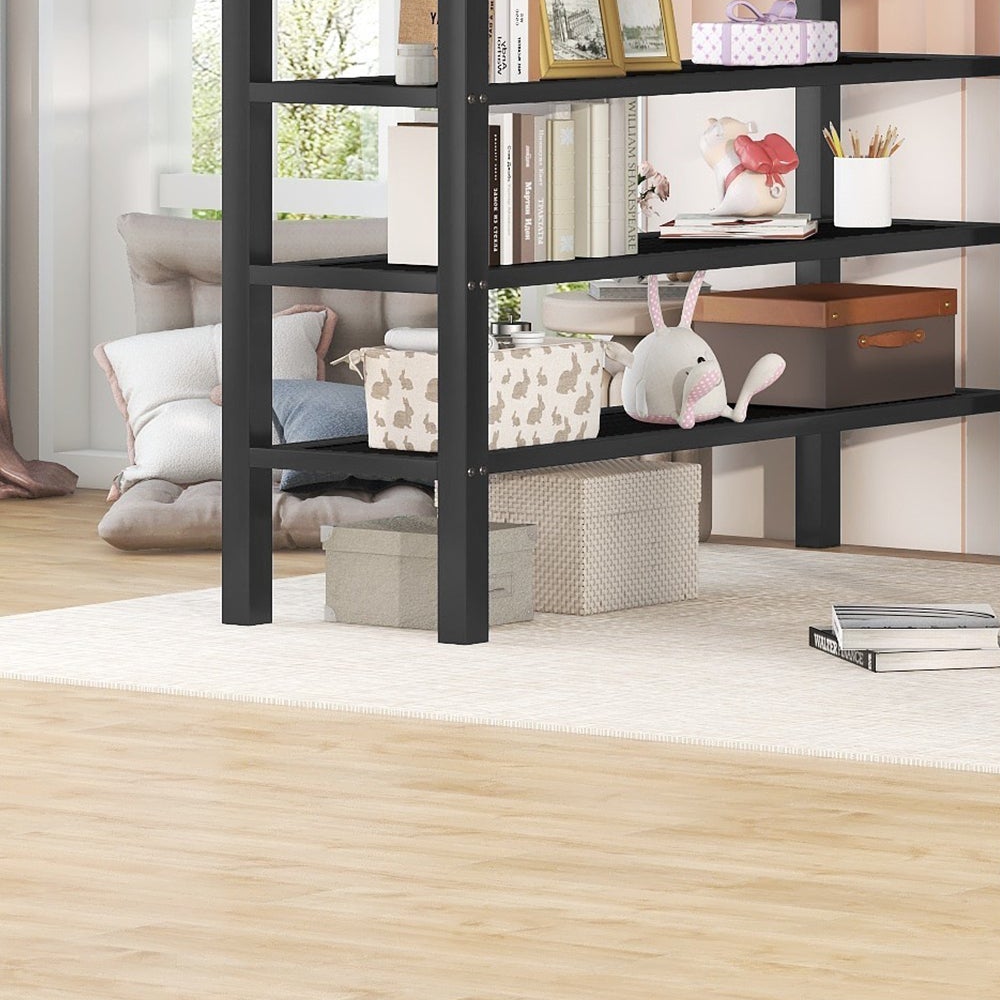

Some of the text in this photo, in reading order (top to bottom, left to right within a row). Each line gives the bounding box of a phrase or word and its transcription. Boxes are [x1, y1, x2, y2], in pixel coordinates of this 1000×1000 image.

[524, 181, 532, 241] Мартин Иден
[628, 100, 637, 251] WILLIAM SHAKESPEARE
